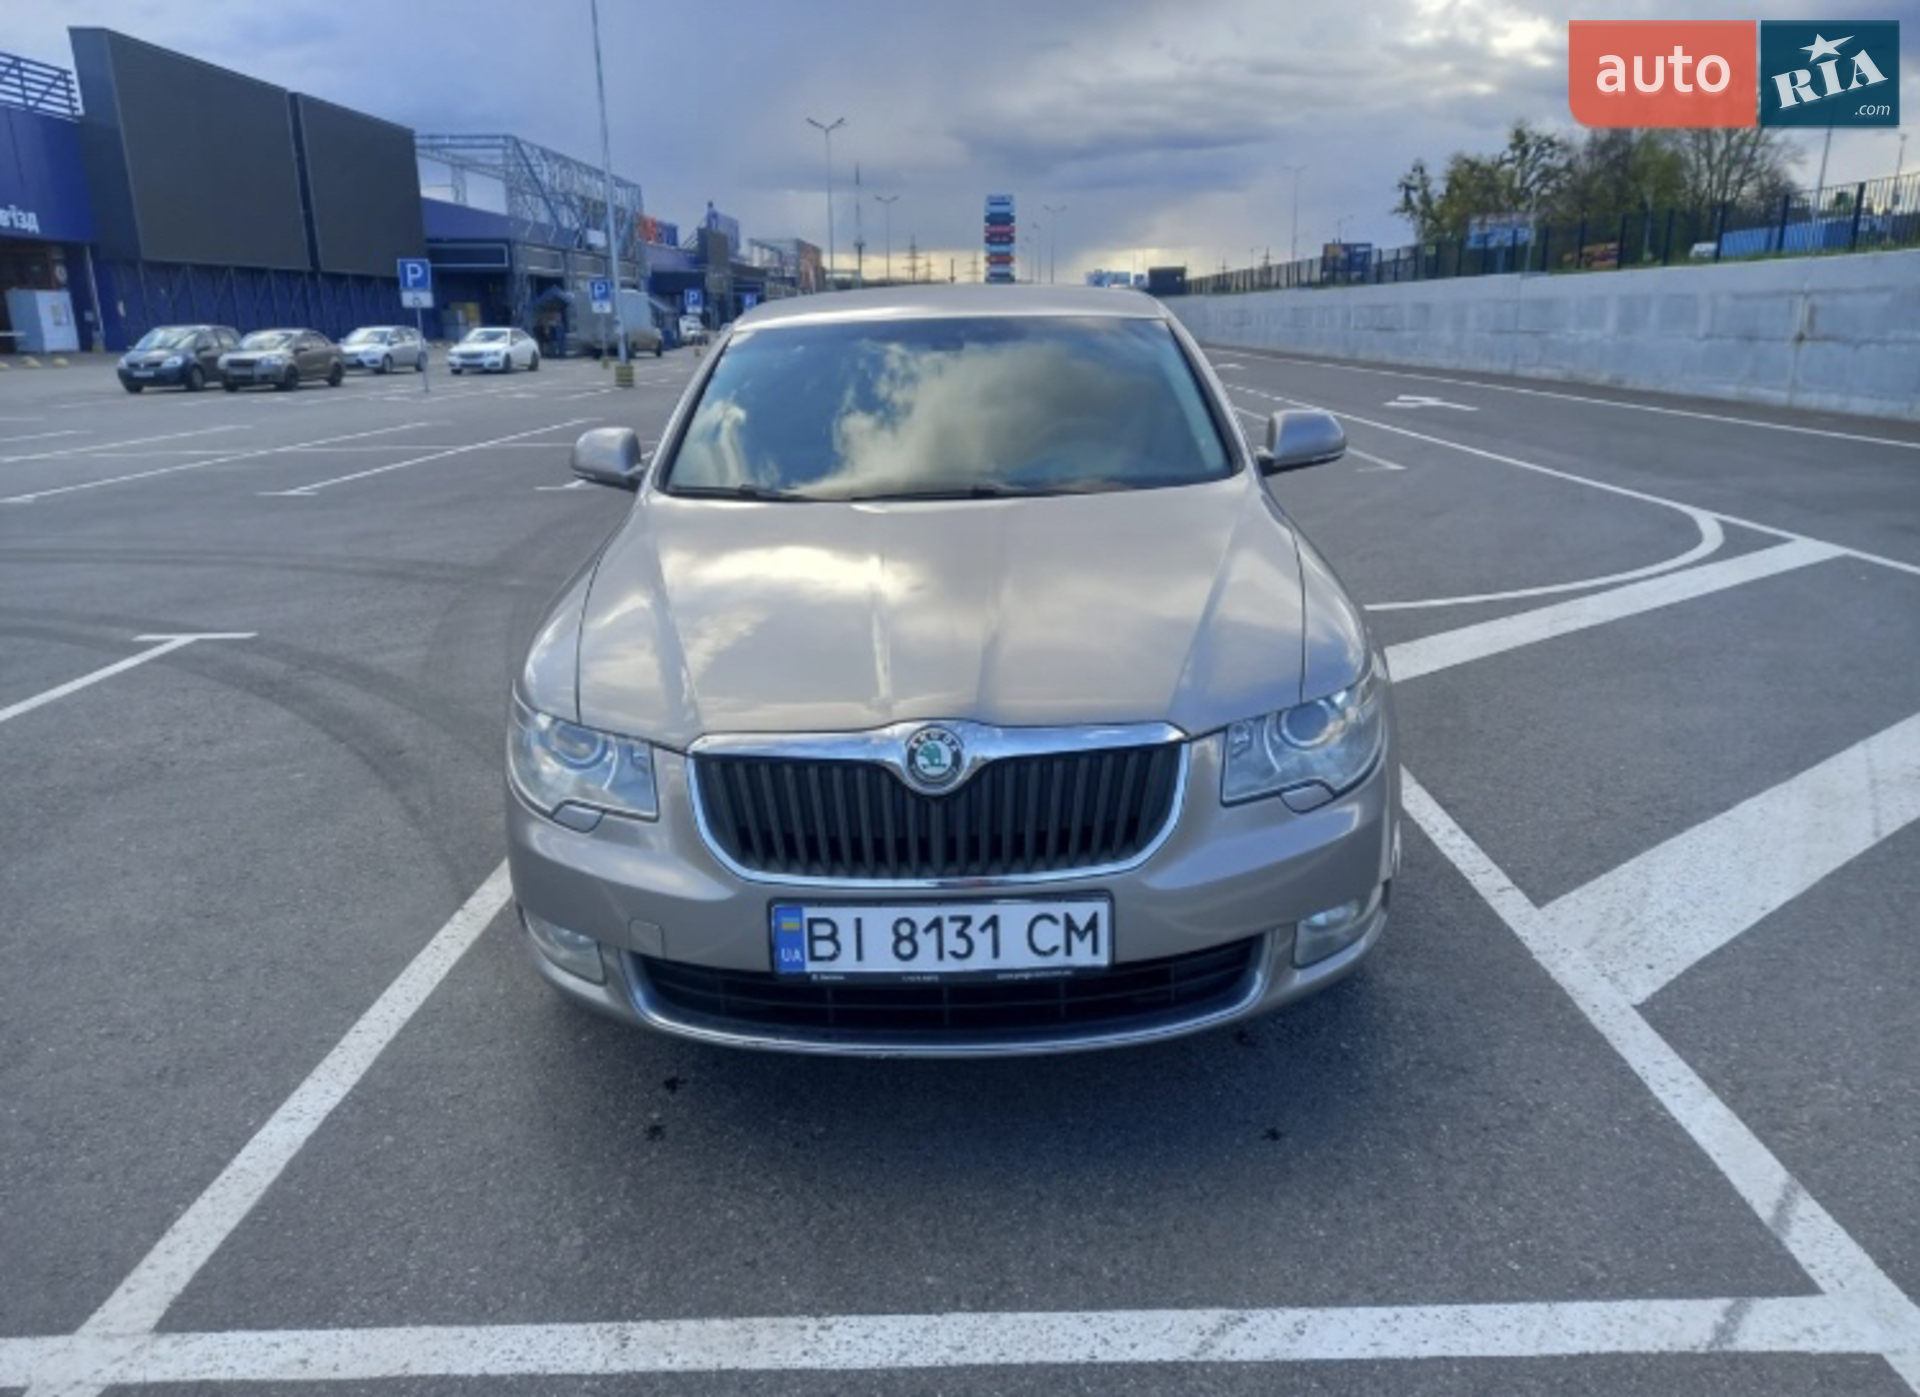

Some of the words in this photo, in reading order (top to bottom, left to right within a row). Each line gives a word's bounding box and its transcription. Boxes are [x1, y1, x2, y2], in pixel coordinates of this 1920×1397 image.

[405, 263, 424, 286] P
[594, 283, 606, 298] P
[688, 291, 699, 306] P
[807, 917, 864, 963] BI
[892, 914, 1001, 962] 8131
[1026, 911, 1100, 959] CM
[781, 947, 804, 964] UA
